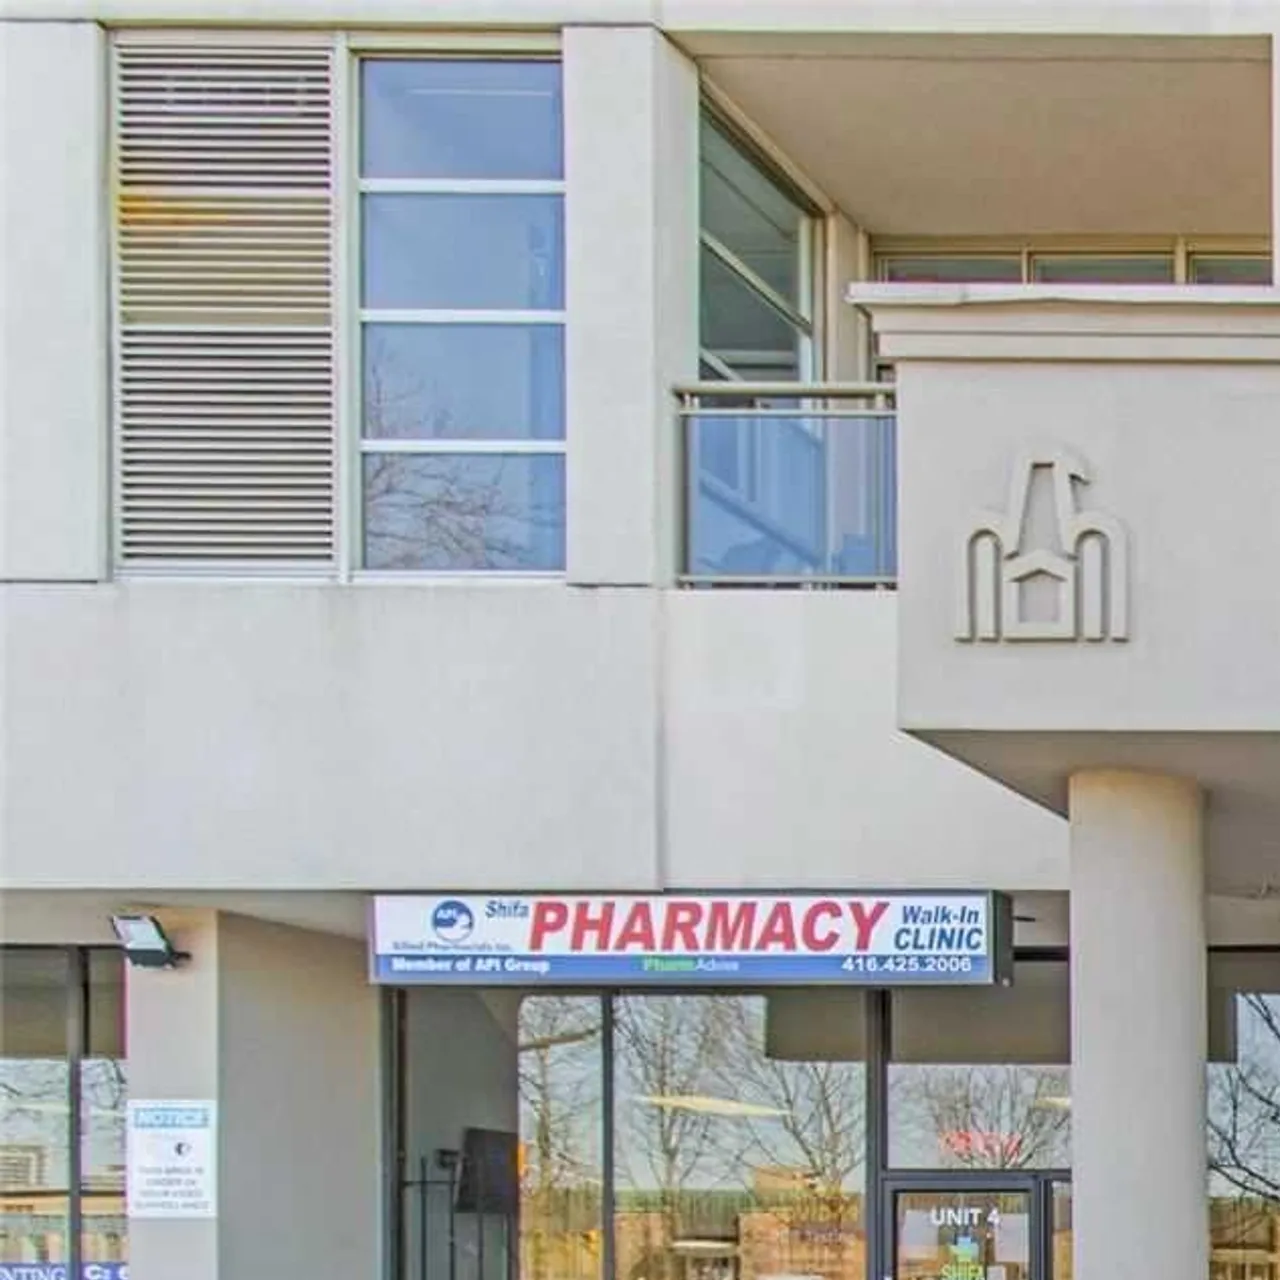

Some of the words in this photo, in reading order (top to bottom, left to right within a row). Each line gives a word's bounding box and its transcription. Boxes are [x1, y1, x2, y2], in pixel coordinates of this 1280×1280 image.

[901, 905, 980, 925] Walk-In
[485, 900, 529, 918] Shifa
[529, 901, 890, 952] PHARMACY
[893, 928, 983, 951] CLINIC
[391, 957, 452, 972] Member
[455, 957, 471, 972] of
[474, 958, 501, 972] API
[504, 957, 550, 976] Group
[841, 956, 972, 973] 416.425.2006
[931, 1207, 982, 1226] UNIT
[986, 1207, 1000, 1227] 4
